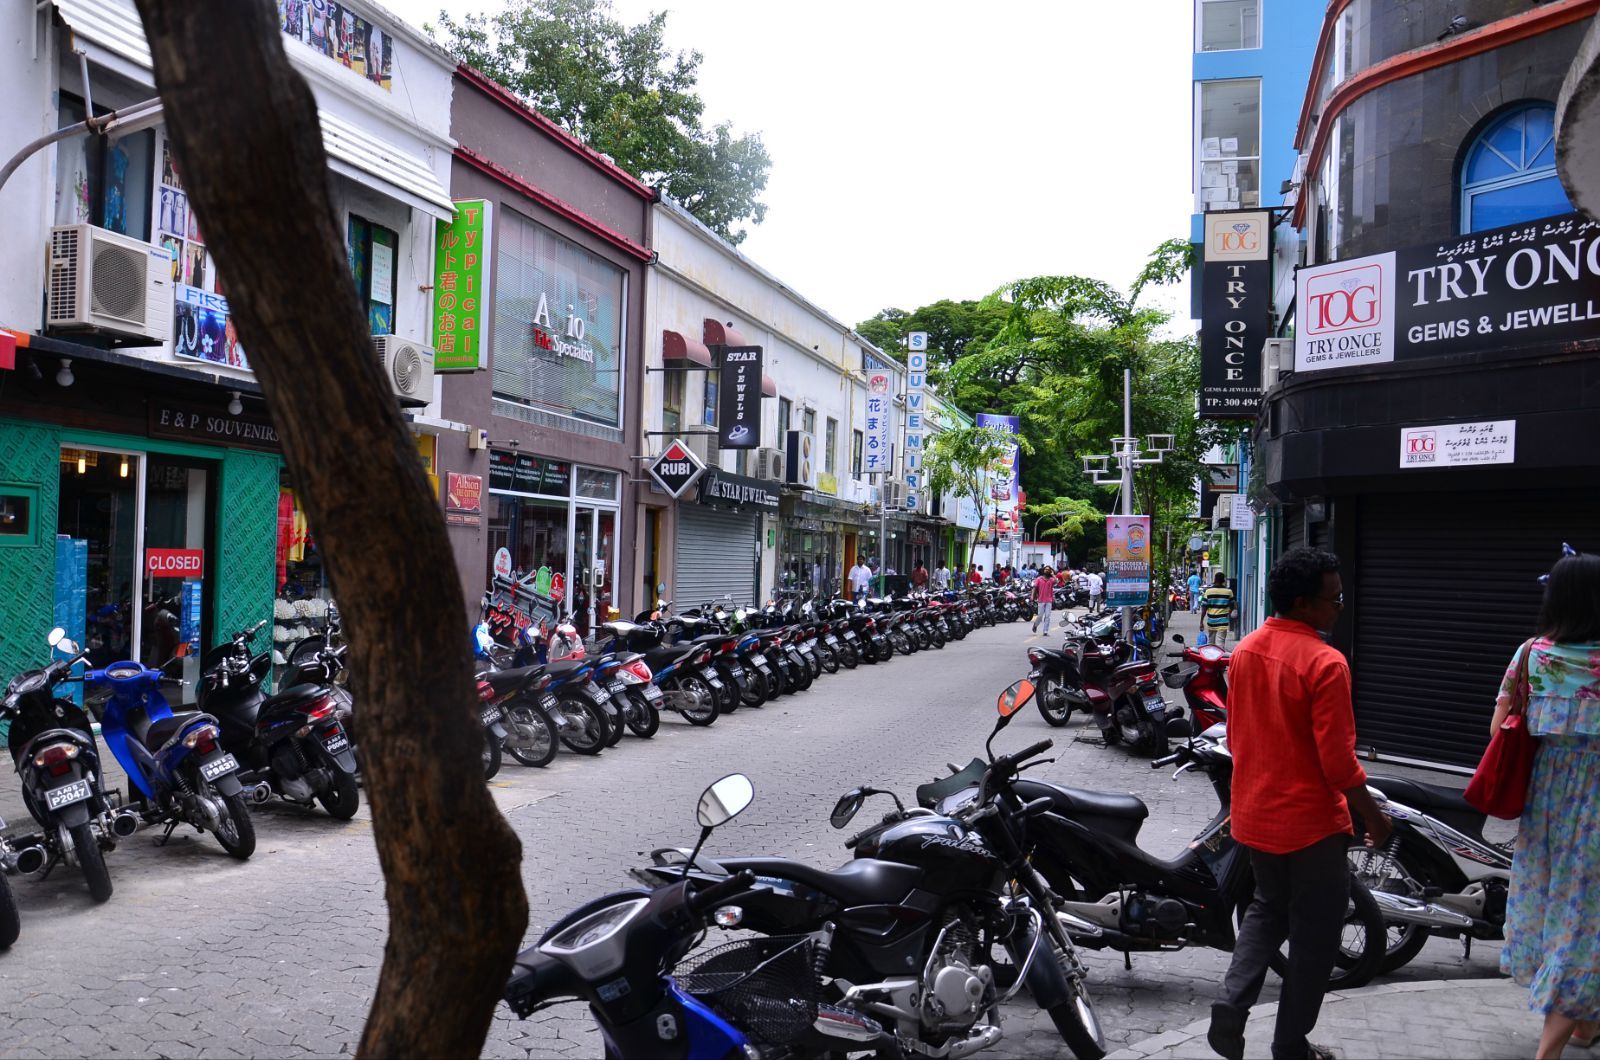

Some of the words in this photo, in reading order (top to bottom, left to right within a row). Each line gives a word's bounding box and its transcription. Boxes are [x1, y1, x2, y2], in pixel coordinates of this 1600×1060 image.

[1216, 232, 1257, 251] TOG
[461, 209, 478, 352] Typical
[1226, 265, 1247, 309] TRY
[1408, 254, 1497, 307] TRY
[1309, 285, 1376, 330] TOG
[1408, 318, 1470, 344] GEMS
[1477, 315, 1493, 335] &
[552, 334, 594, 363] Specialist
[1224, 321, 1247, 381] ONCE
[1307, 338, 1336, 355] TRY
[1338, 332, 1382, 351] ONCE
[726, 352, 757, 362] STAR
[1306, 354, 1326, 363] GEMS
[1328, 353, 1333, 361] &
[1335, 348, 1381, 360] JEWELLERS
[736, 365, 747, 420] JEWELS
[1205, 398, 1222, 406] TP:
[1224, 398, 1240, 407] 300
[160, 409, 170, 426] E
[174, 412, 185, 428] &
[190, 414, 199, 430] P
[905, 335, 923, 508] SOUVENIRS
[867, 399, 880, 468] 花まる子
[1407, 438, 1434, 452] TOG
[660, 464, 691, 475] RUBI
[456, 475, 479, 489] Albion
[721, 482, 740, 500] STAR
[149, 555, 201, 571] CLOSED
[52, 788, 86, 806] P2047
